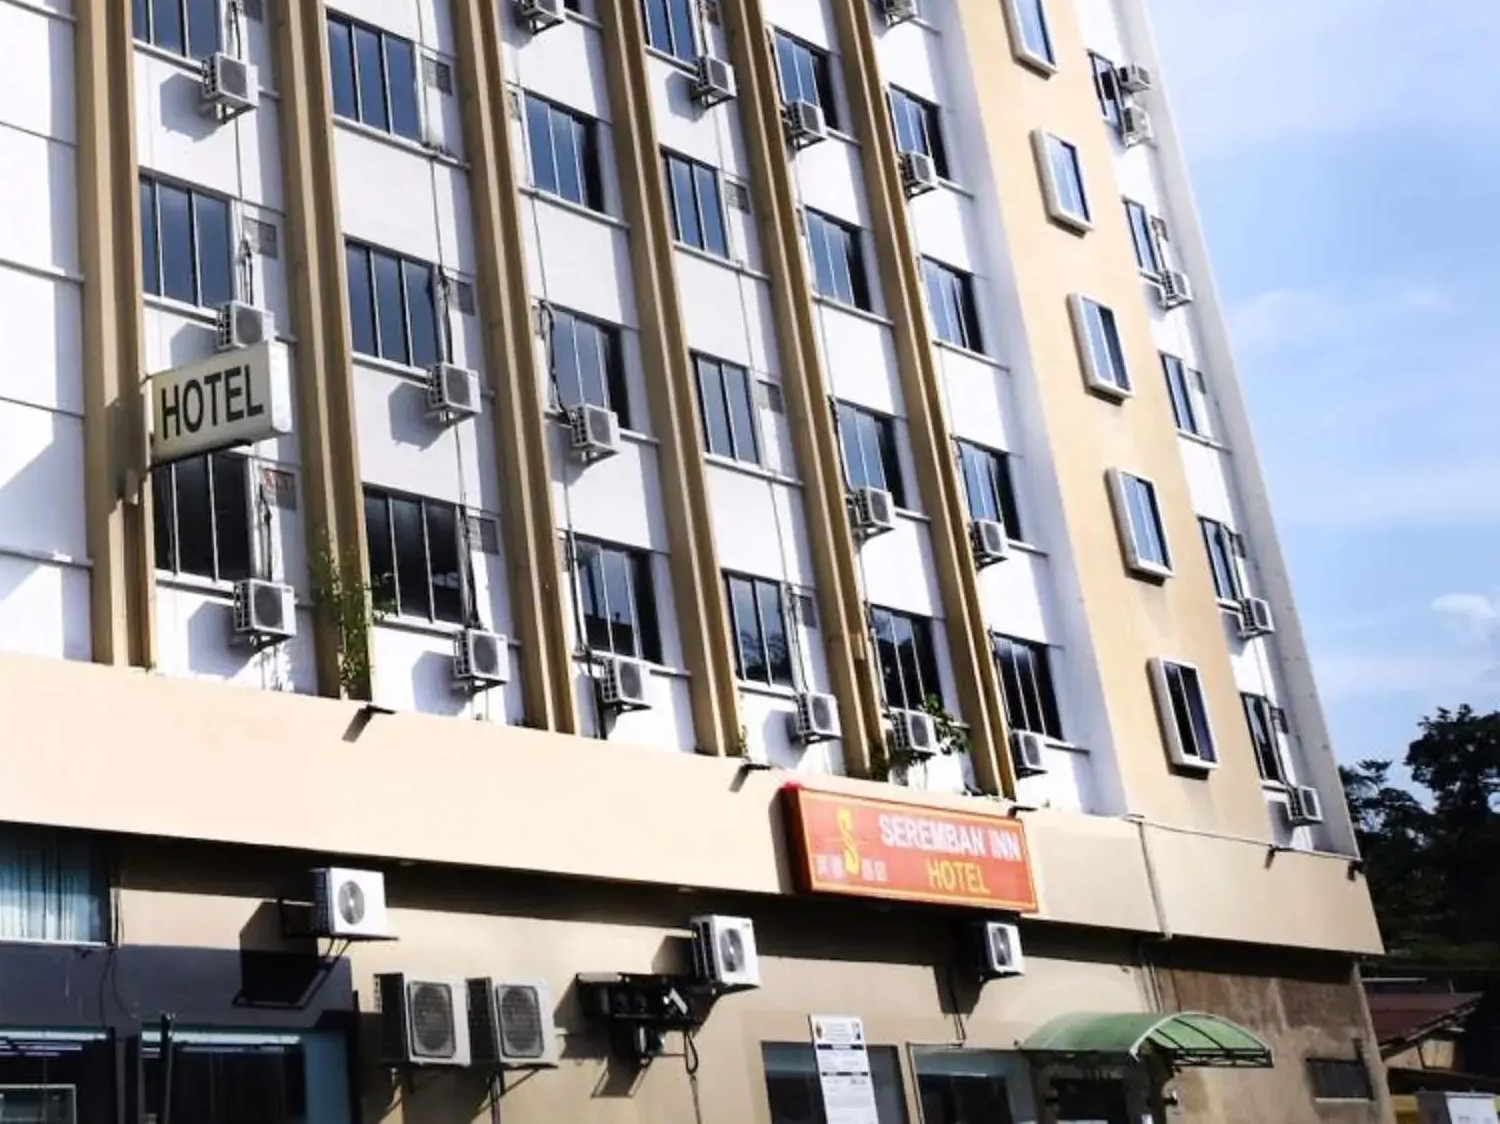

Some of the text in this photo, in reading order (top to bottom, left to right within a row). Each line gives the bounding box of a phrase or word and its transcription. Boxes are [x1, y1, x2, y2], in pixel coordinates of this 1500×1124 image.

[161, 364, 264, 440] HOTEL
[878, 814, 1022, 861] SEREMBAN INN
[925, 857, 992, 894] HOTEL
